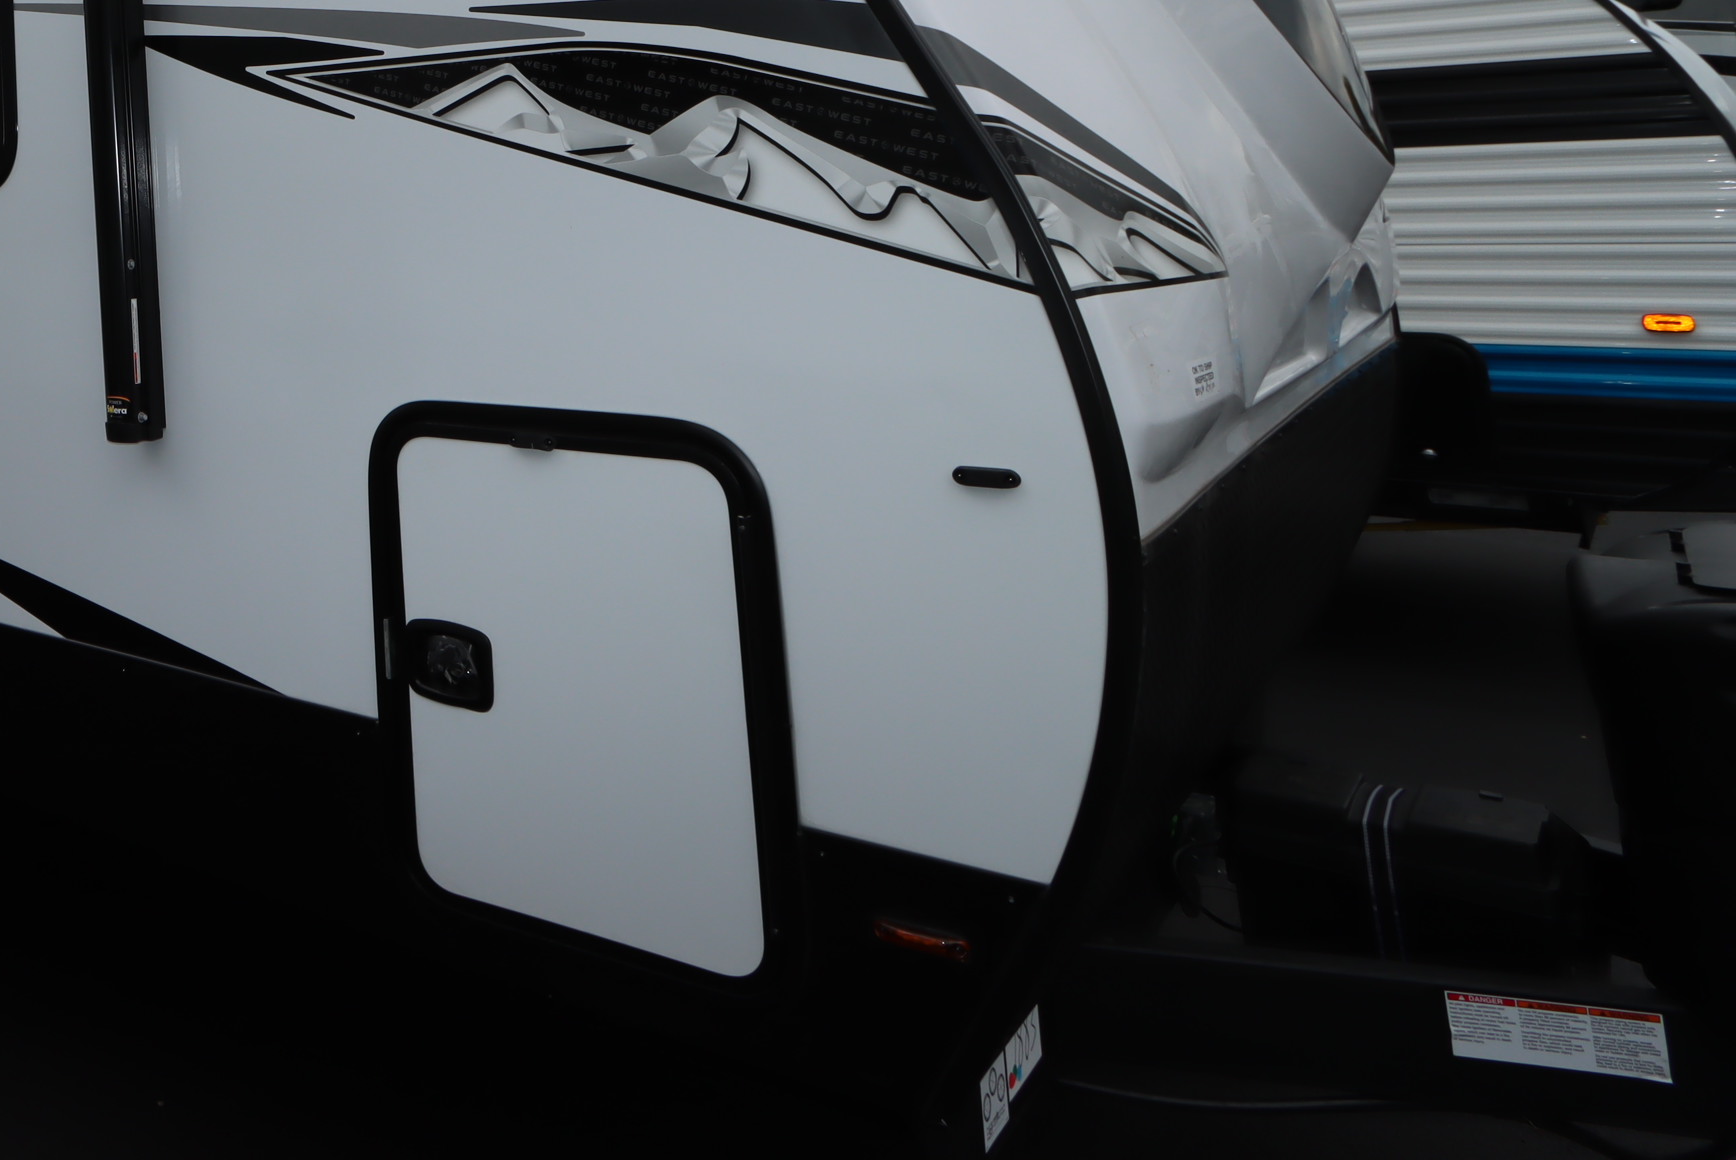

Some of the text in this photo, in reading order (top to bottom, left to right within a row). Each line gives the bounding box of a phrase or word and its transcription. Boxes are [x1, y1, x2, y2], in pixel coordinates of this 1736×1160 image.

[586, 72, 672, 99] EAST WEST
[648, 69, 686, 85] EAST
[575, 87, 612, 102] WEST
[771, 96, 872, 126] EAST WEST
[834, 130, 940, 161] EAST WEST
[902, 165, 950, 183] EAST
[1468, 995, 1504, 1005] DANGER
